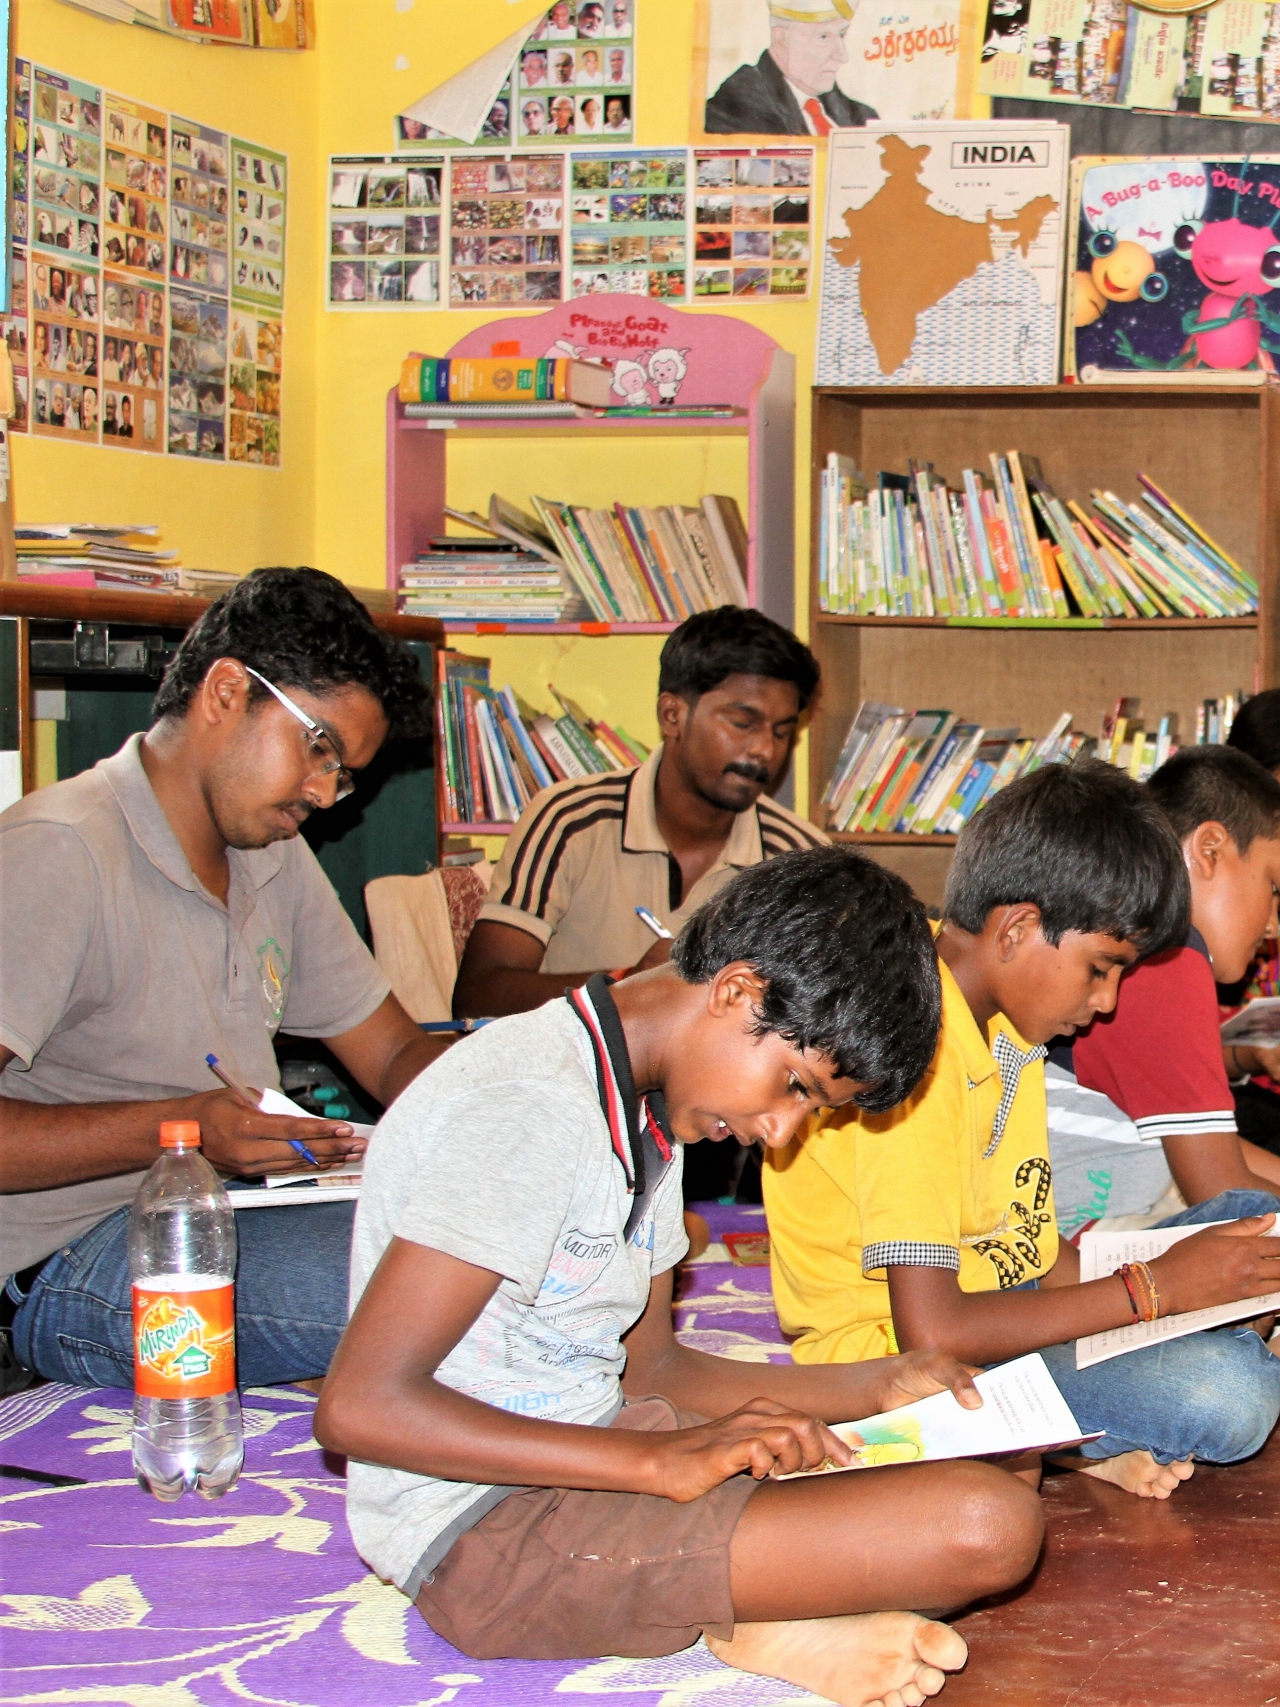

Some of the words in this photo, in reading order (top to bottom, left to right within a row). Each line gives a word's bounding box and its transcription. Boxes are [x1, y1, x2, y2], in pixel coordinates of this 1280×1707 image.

[963, 146, 1036, 164] INDIA
[1085, 205, 1102, 222] A
[1101, 171, 1206, 208] Bug-a-Boo
[1211, 170, 1254, 195] Day
[550, 734, 578, 768] KARNATAKA
[562, 1235, 613, 1259] MOTOR
[550, 1251, 604, 1280] ENJOY
